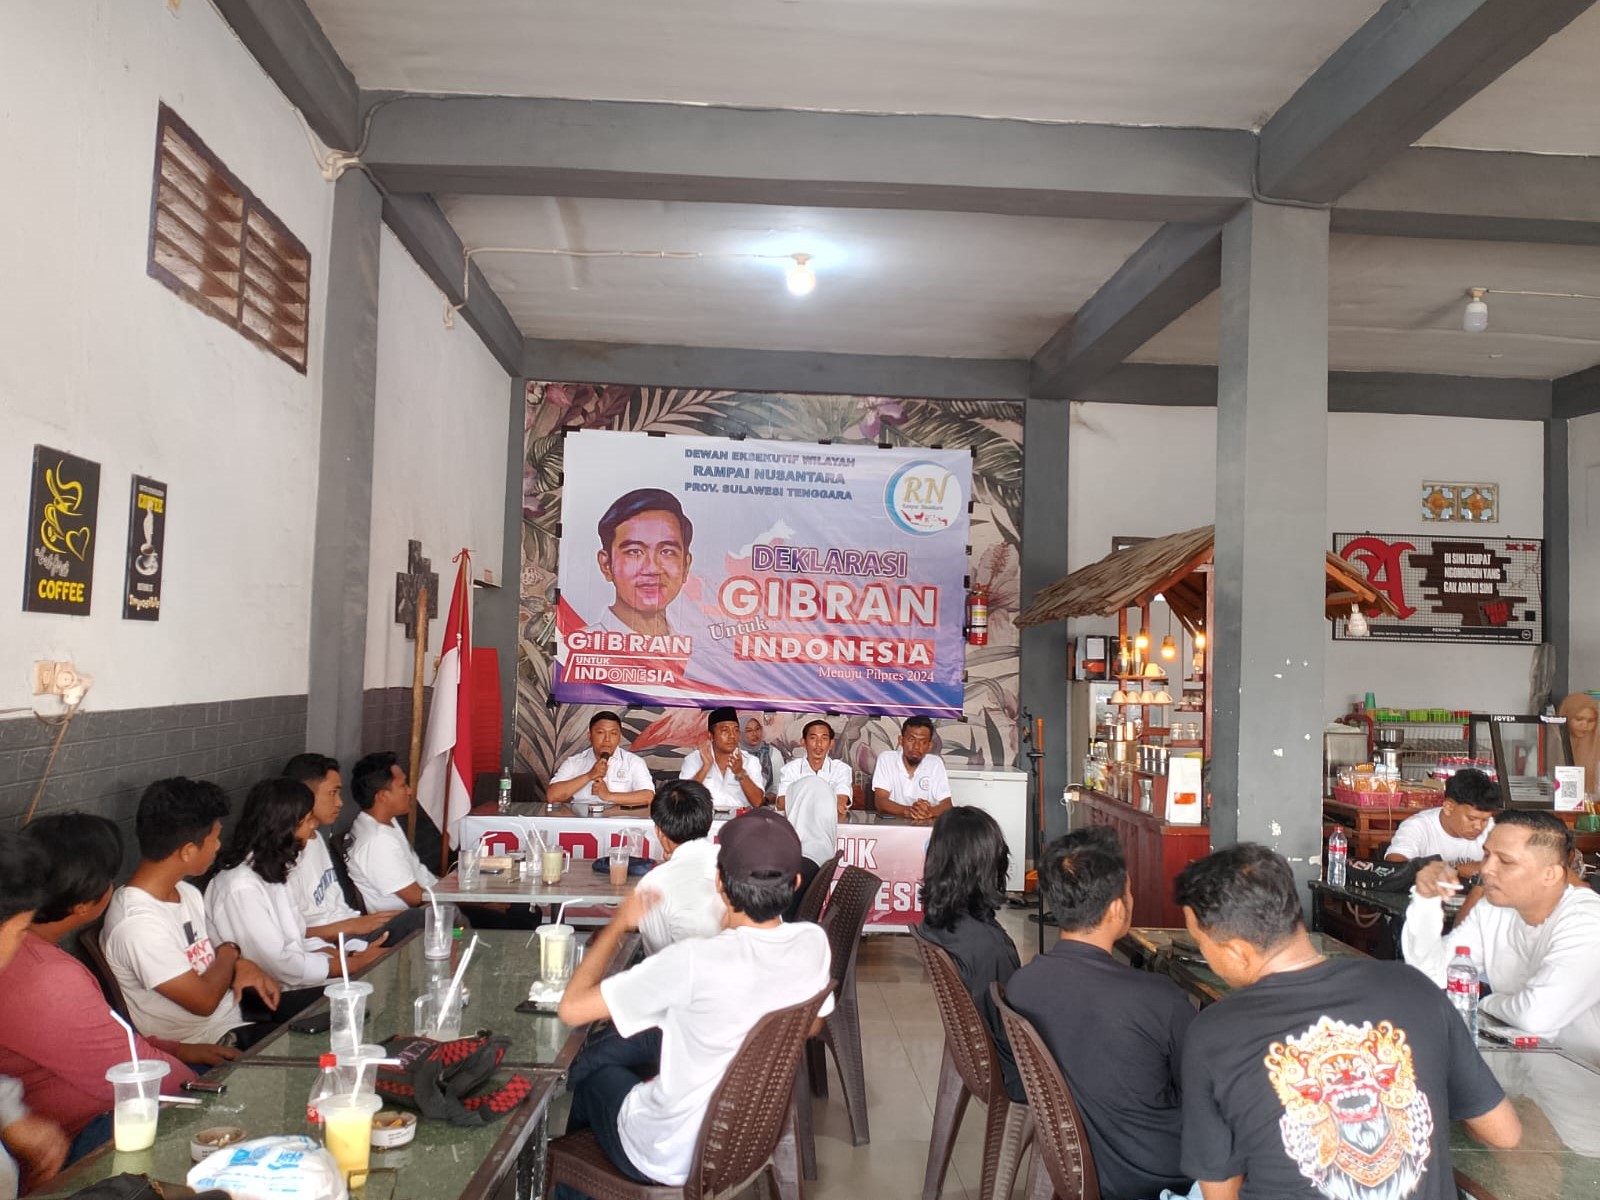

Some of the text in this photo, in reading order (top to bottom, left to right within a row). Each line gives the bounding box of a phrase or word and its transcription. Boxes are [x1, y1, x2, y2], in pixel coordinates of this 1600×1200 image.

[684, 448, 856, 468] DEWAN EKSEKUTIF WILAYAH
[693, 465, 846, 485] RAMPAI NUSANTARA
[684, 482, 853, 501] PROV. SULAWESI TENGGARA
[903, 472, 952, 504] RN
[752, 545, 908, 578] DEKLARASI
[1466, 553, 1491, 566] TEMPAT
[1483, 567, 1501, 580] YANG
[38, 579, 85, 602] COFFEE
[1458, 581, 1472, 594] ADA
[720, 577, 937, 626] GIBRAN
[709, 616, 769, 641] Untuk
[567, 631, 691, 655] GIBRAN
[740, 634, 931, 665] INDONESIA
[575, 656, 611, 665] UNTUK
[573, 666, 676, 682] INDONESIA
[818, 665, 935, 683] Menuju Pilpres 2024
